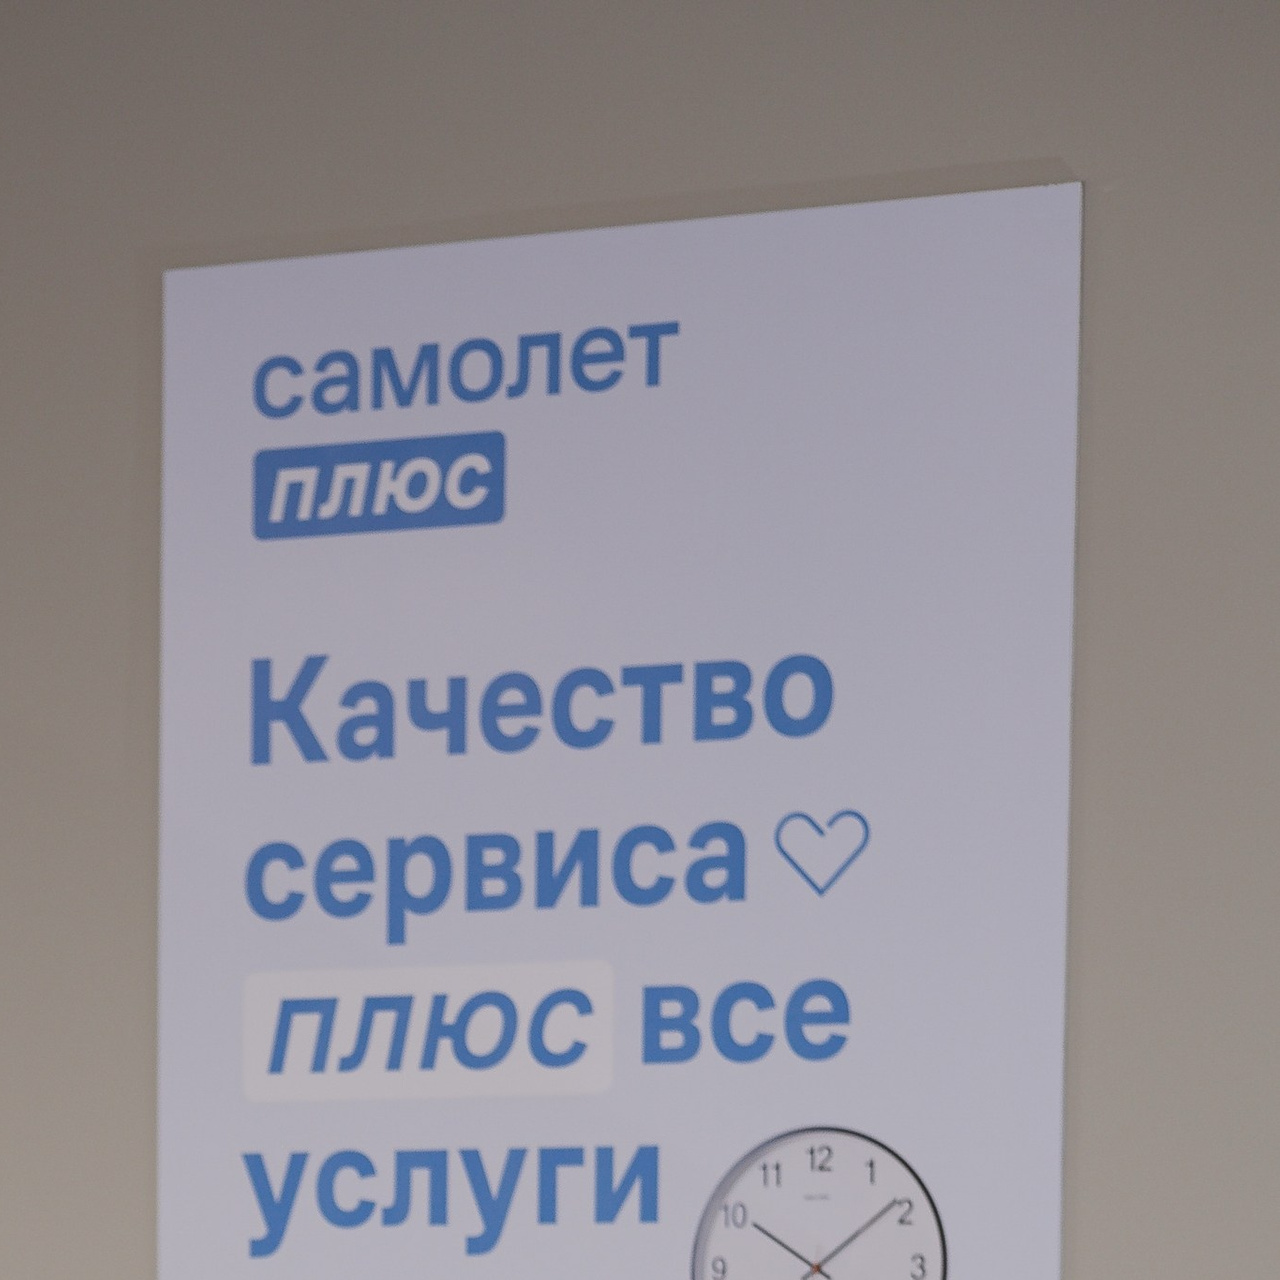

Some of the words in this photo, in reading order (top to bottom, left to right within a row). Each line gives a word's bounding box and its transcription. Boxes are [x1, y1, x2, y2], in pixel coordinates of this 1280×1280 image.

[253, 321, 680, 419] самолет
[268, 453, 492, 523] плюс
[250, 654, 835, 766] Качество
[245, 820, 748, 946] сервиса
[268, 988, 594, 1075] плюс
[641, 978, 852, 1065] все
[759, 1160, 782, 1187] 11
[806, 1145, 834, 1173] 12
[865, 1158, 877, 1186] 1
[242, 1145, 661, 1260] услуги
[720, 1201, 748, 1230] 10
[896, 1197, 915, 1226] 2
